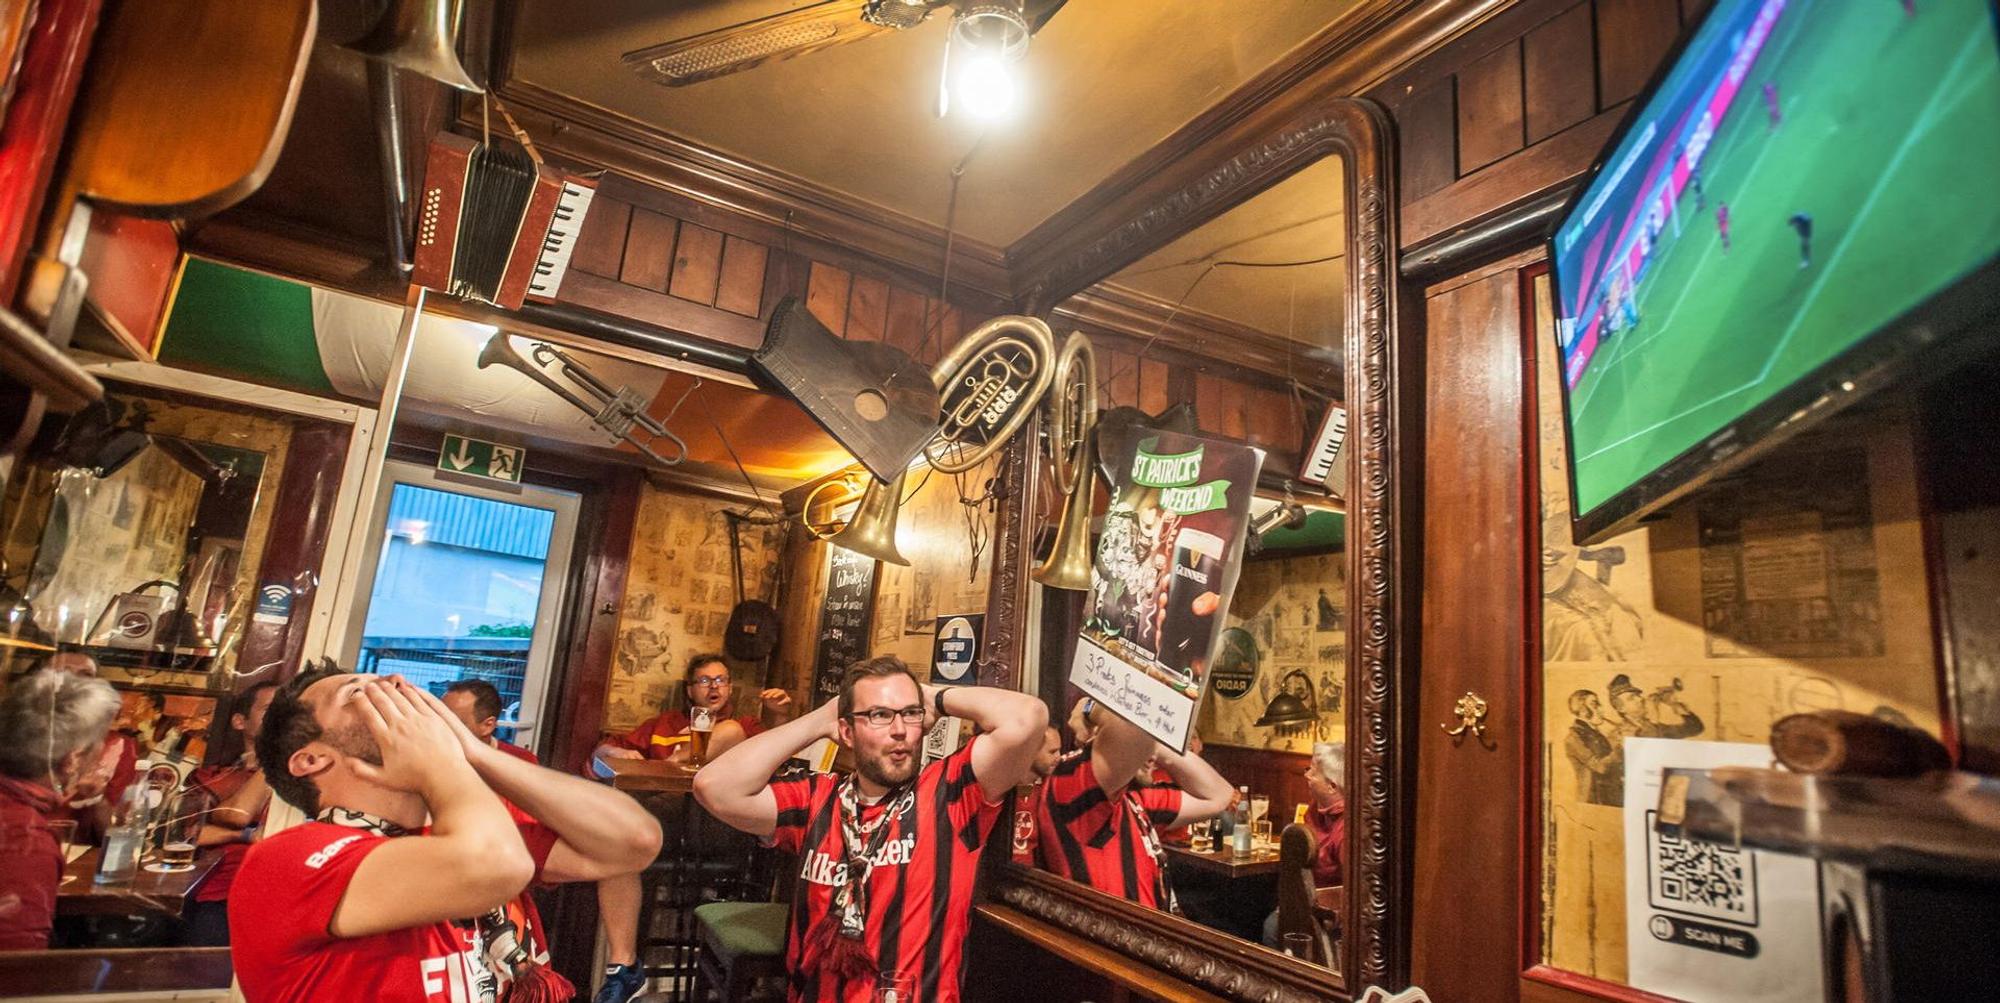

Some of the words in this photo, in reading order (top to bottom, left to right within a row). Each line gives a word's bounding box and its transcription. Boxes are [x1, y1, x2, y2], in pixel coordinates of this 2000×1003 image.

[1131, 455, 1149, 480] ST
[1146, 454, 1201, 484] PATRICK'S
[1160, 485, 1213, 513] WEEKEND
[1175, 563, 1208, 585] GUINNESS
[1085, 653, 1095, 673] 3
[1684, 927, 1721, 944] SCAN
[1724, 934, 1745, 951] ME
